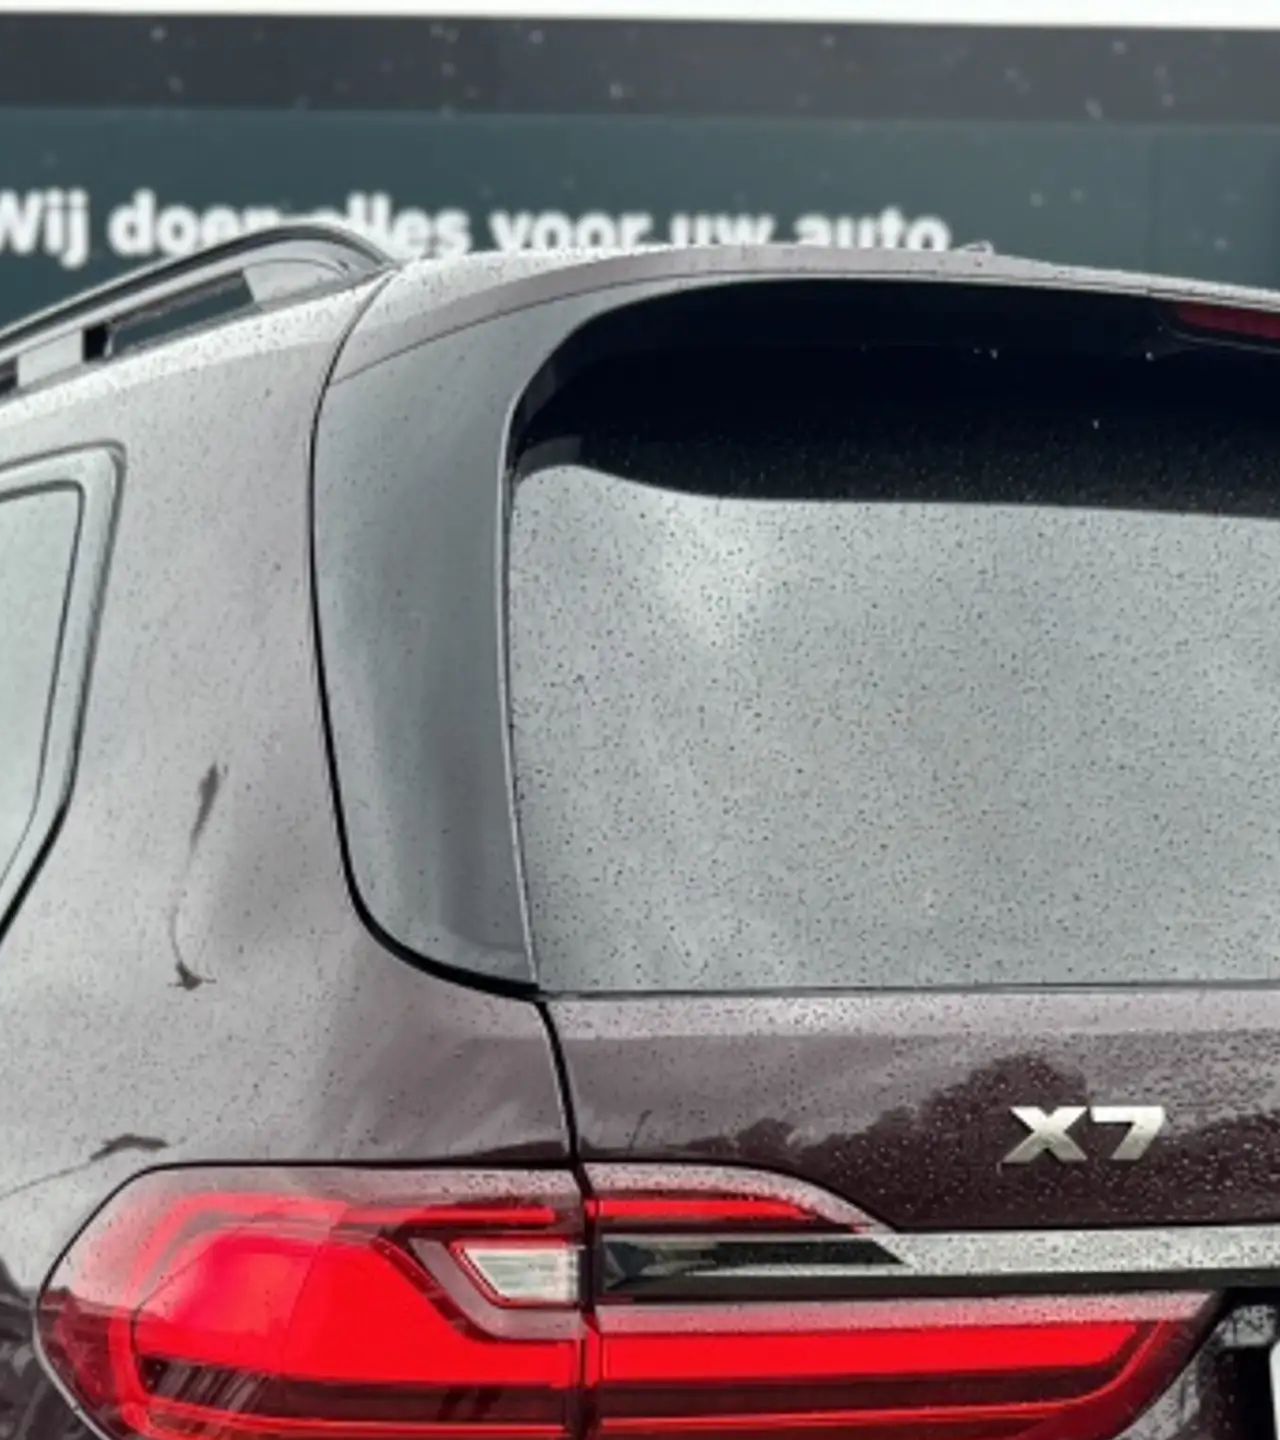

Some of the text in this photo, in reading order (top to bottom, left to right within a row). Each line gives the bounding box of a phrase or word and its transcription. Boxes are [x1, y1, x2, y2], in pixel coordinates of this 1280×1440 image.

[489, 210, 653, 254] voor
[669, 212, 775, 247] uw
[794, 205, 950, 251] auto
[1001, 1105, 1166, 1164] X7
